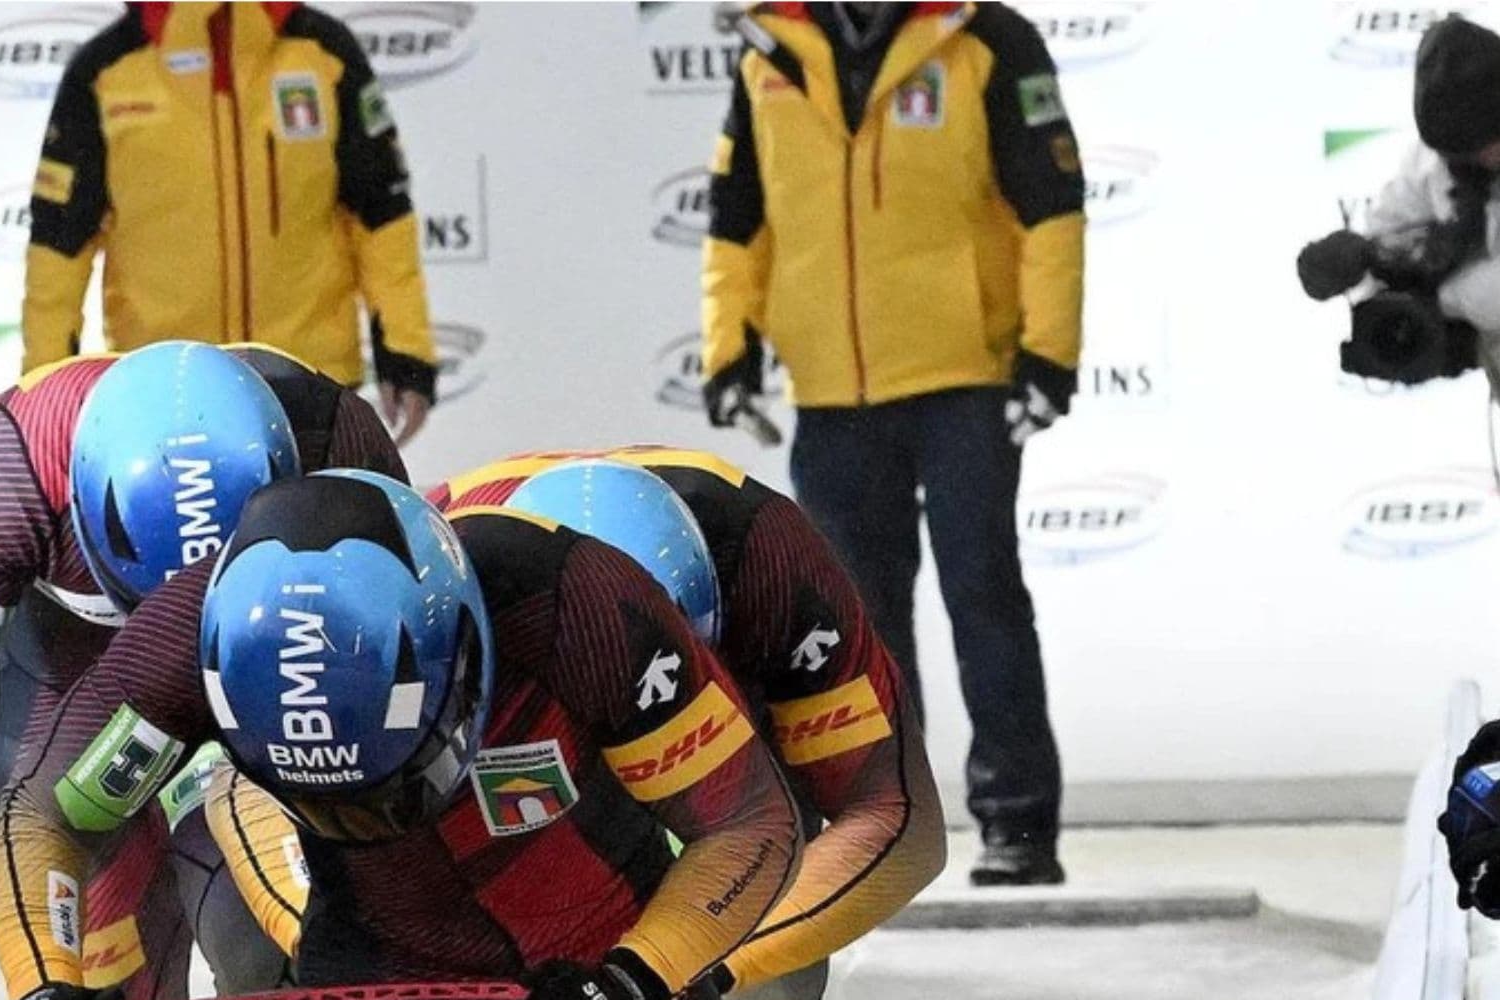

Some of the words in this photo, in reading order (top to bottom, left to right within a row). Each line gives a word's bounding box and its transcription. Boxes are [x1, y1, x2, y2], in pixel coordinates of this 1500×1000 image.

[1039, 16, 1132, 38] BSF
[1355, 11, 1435, 32] IBS
[357, 31, 453, 55] BSF
[652, 46, 736, 81] VELT
[1027, 506, 1143, 532] IBSF
[1366, 501, 1483, 524] IBSF
[283, 584, 326, 595] i
[280, 609, 334, 742] BMW
[267, 744, 360, 768] BMW
[617, 715, 726, 783] DHL
[276, 767, 365, 785] helmets
